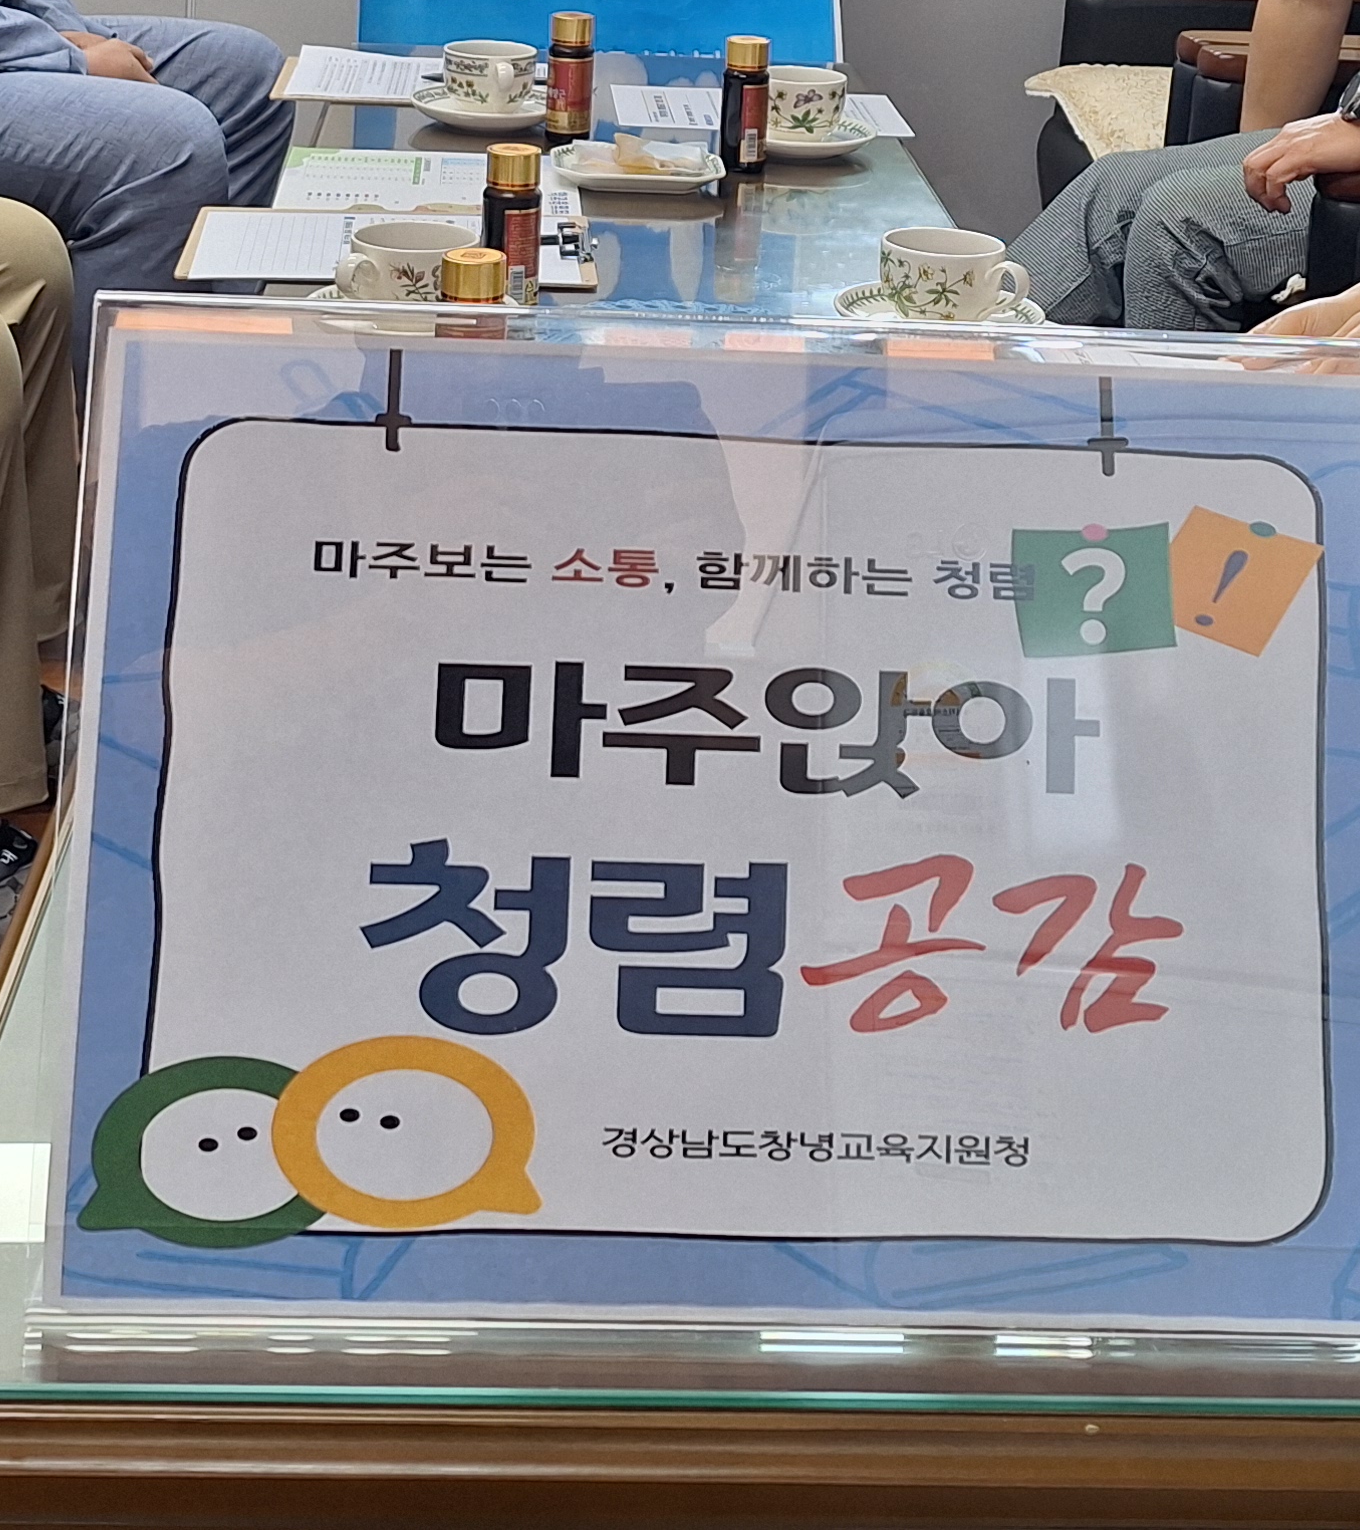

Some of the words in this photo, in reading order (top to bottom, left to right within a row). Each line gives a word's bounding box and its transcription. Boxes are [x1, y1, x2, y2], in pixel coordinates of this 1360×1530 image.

[313, 539, 532, 583] 마주보는
[551, 547, 675, 595] 소통,
[696, 550, 913, 598] 함께하는
[932, 557, 1037, 602] 청렴
[434, 660, 1101, 799] 마주앉아
[602, 1126, 1031, 1168] 경상남도창녕교육지원청
